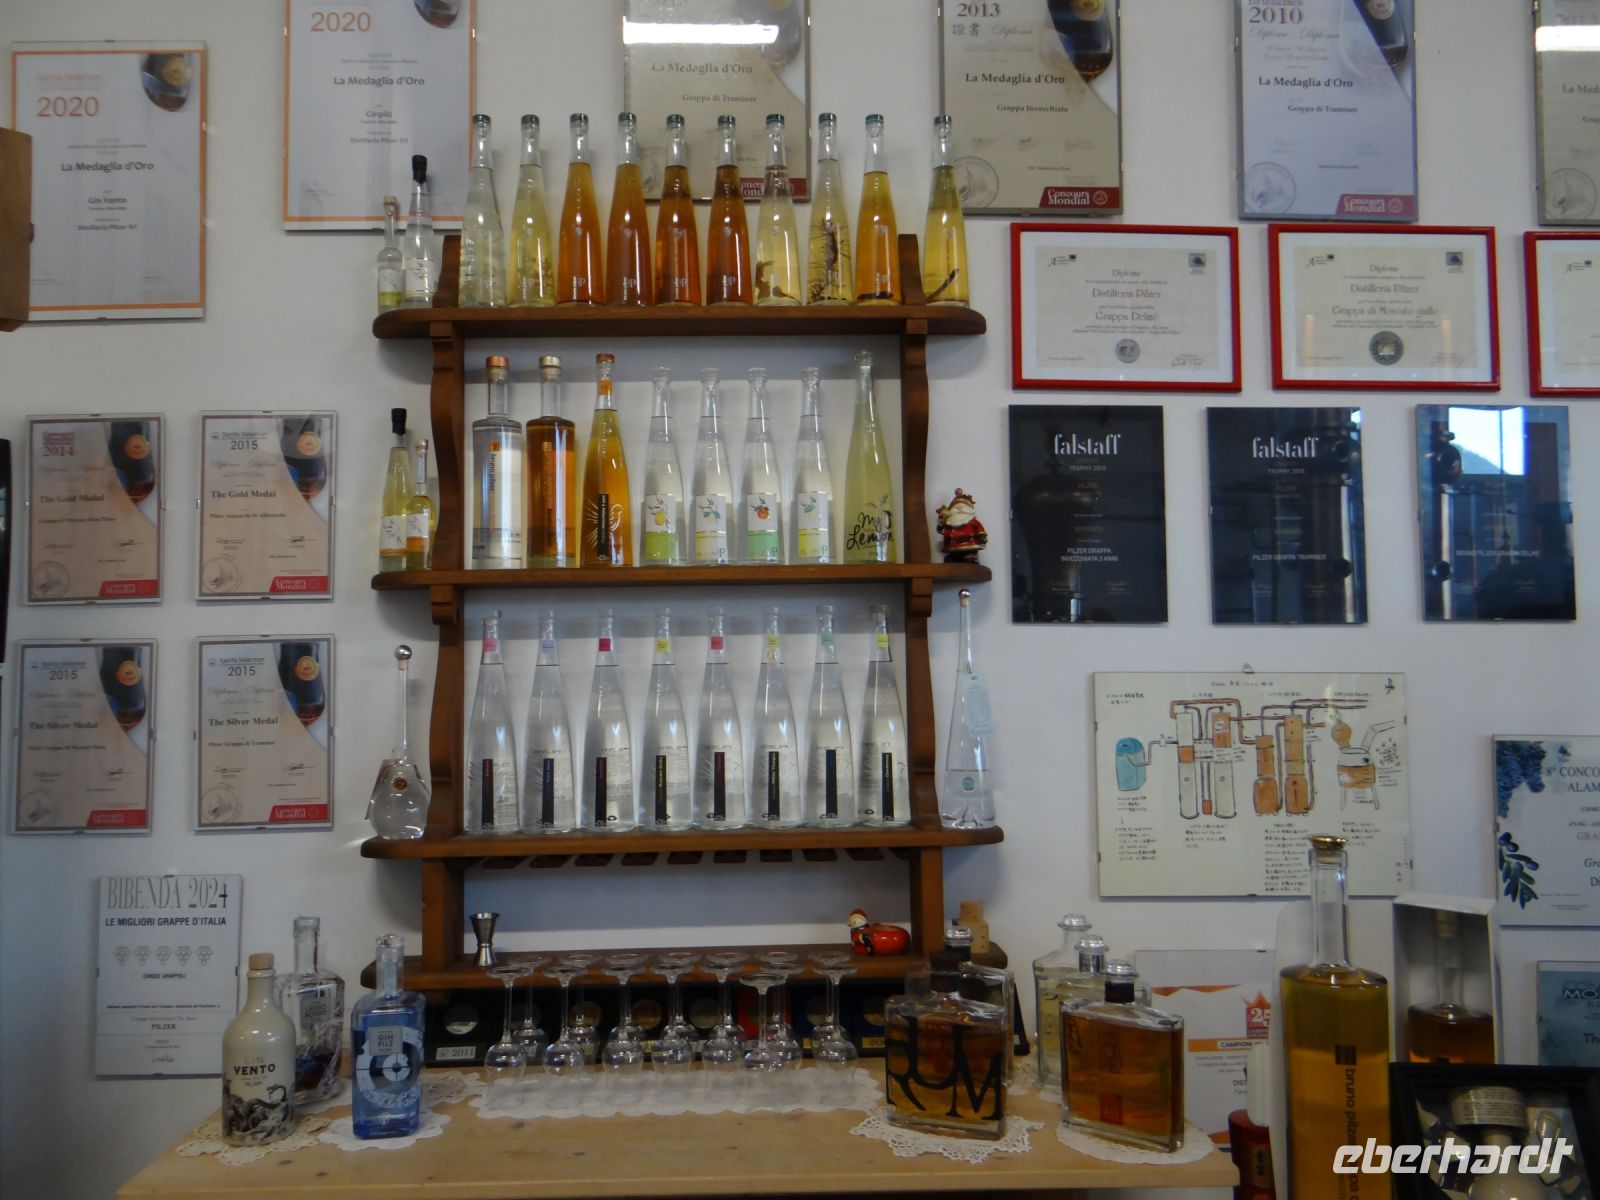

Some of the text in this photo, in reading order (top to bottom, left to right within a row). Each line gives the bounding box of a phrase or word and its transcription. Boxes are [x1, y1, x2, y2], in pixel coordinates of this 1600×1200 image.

[957, 3, 1000, 17] 2013
[1249, 7, 1303, 25] 2010
[311, 11, 371, 32] 2020
[652, 62, 753, 75] La Medaglia d'Oro
[334, 76, 425, 87] La Medaglia d'Oro
[965, 73, 1065, 86] La Medaglia d'Oro
[1258, 76, 1354, 89] La Medaglia d'Oro
[1562, 85, 1574, 94] La
[37, 96, 99, 118] 2020
[61, 160, 154, 173] La Medaglia d'Oro
[1048, 196, 1090, 206] Mondial
[231, 441, 258, 450] 2015
[1054, 433, 1122, 455] falstaff
[1252, 437, 1319, 459] falstaff
[43, 446, 74, 457] 2014
[211, 491, 226, 499] The
[250, 490, 277, 498] Medal
[857, 511, 882, 533] My
[846, 524, 894, 550] Lemon
[50, 670, 78, 681] 2015
[228, 666, 256, 677] 2015
[30, 722, 45, 730] The
[209, 716, 279, 727] The Silver Medal
[107, 877, 228, 909] BIBENDA 2024
[105, 916, 227, 927] LE MIGLIORI GRAPPE D'ITALIA
[377, 1033, 394, 1041] GIN
[233, 1063, 276, 1076] VENTO
[886, 1015, 1001, 1121] RUM
[1345, 1068, 1357, 1142] bruno pilze
